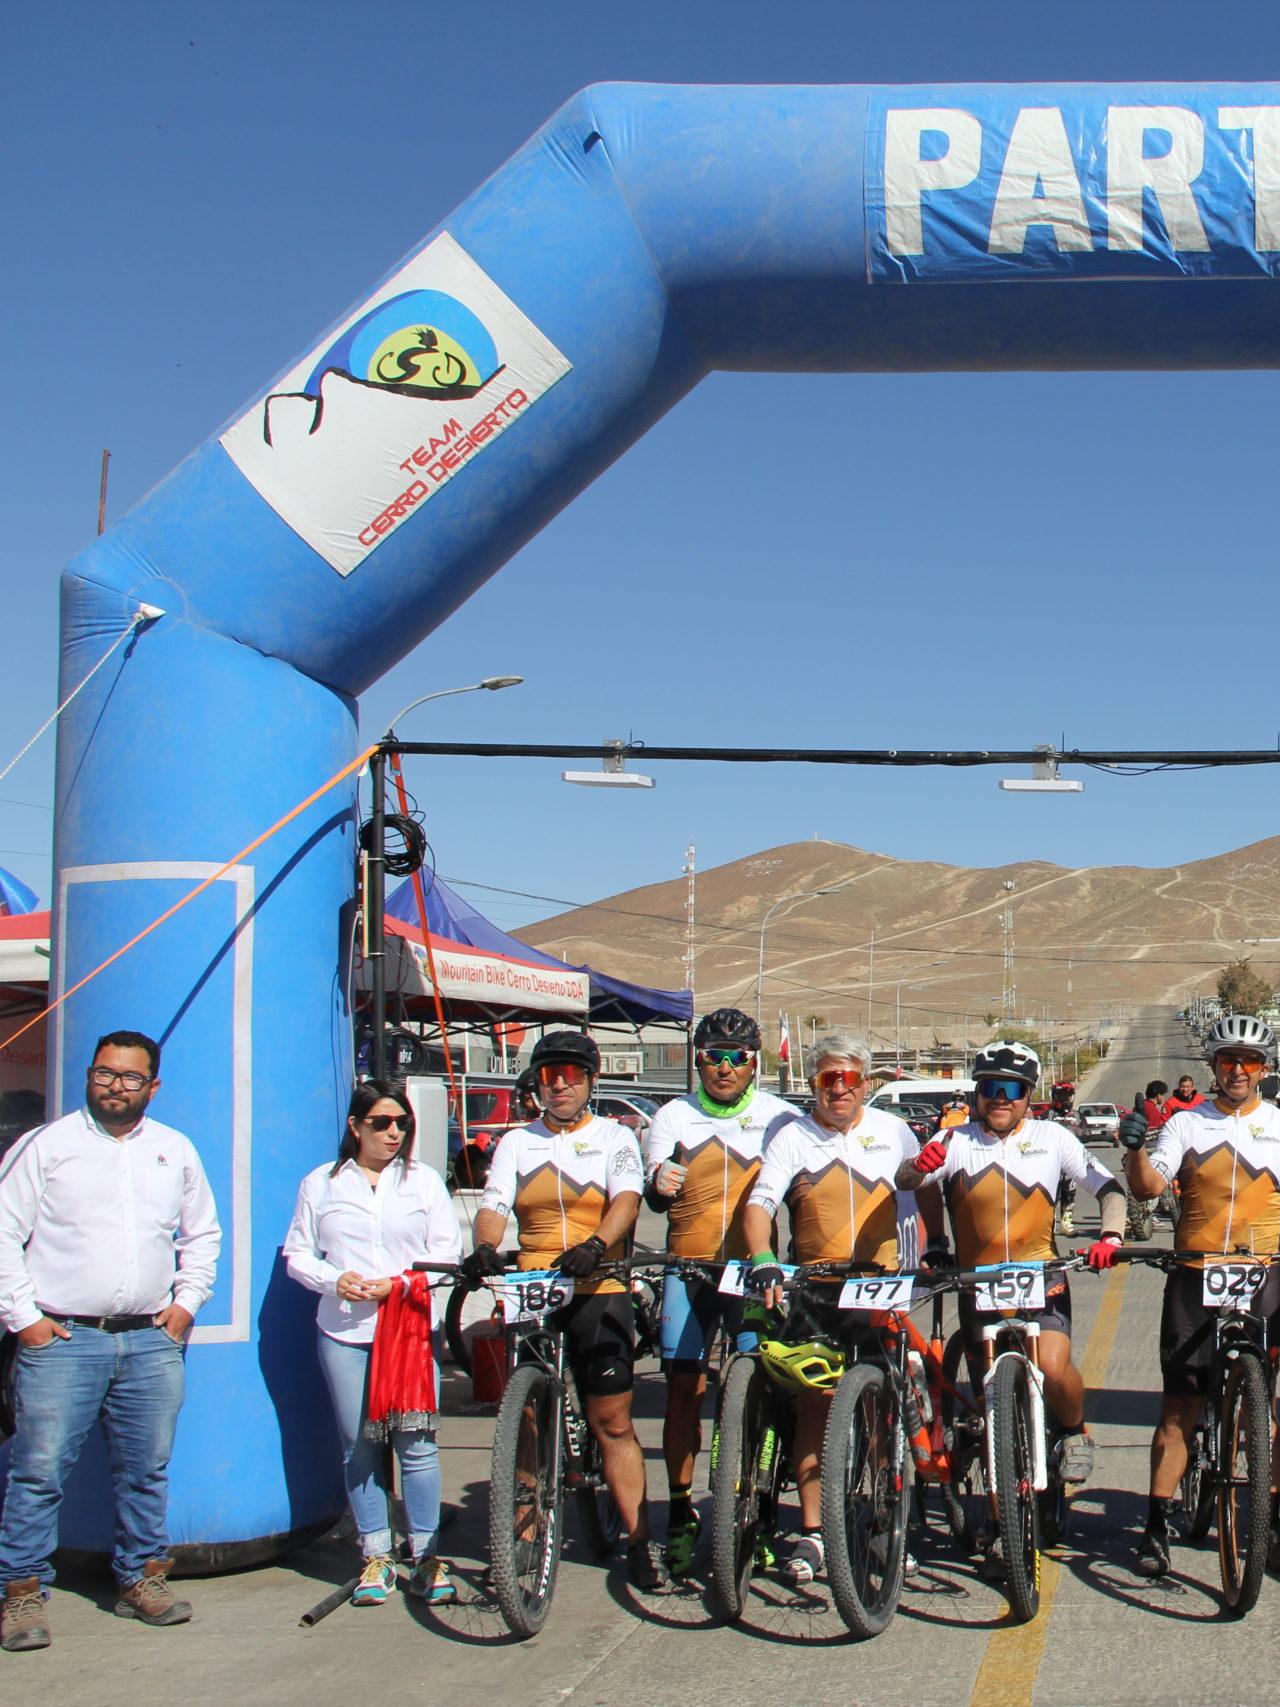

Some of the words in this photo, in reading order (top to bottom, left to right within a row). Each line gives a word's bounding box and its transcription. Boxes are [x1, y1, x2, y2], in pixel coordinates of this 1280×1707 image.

[400, 418, 463, 476] TEAM
[358, 480, 429, 547] CERRO
[426, 388, 528, 482] DESIERTO
[440, 959, 484, 983] Mountain
[485, 965, 506, 987] Bike
[507, 970, 531, 991] Cerro
[532, 975, 566, 996] Desierto
[565, 980, 585, 1000] DDA
[855, 1280, 903, 1300] 197
[989, 1271, 1035, 1299] 159
[1206, 1265, 1265, 1296] 029
[516, 1281, 566, 1312] 186
